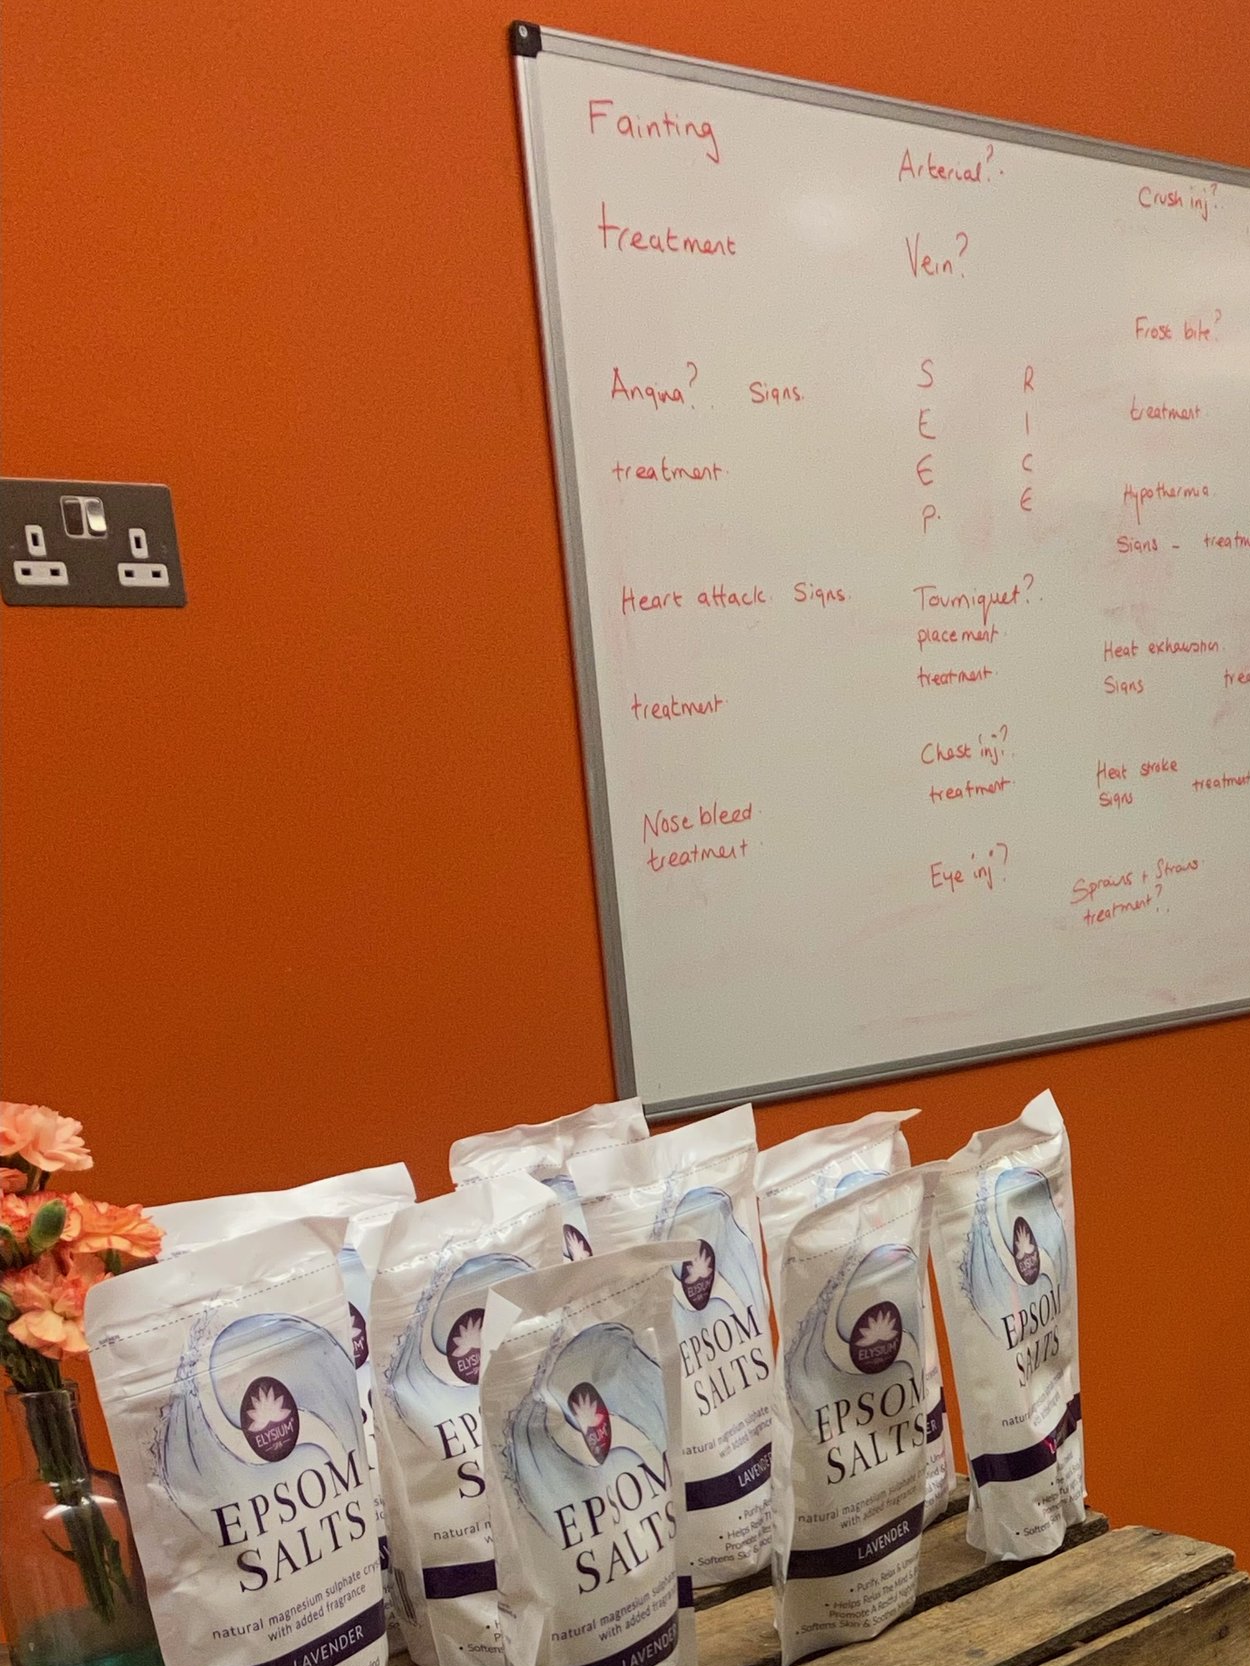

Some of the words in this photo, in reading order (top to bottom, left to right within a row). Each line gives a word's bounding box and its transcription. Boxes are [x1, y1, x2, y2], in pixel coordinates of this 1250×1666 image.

[588, 99, 721, 164] Fainting
[1138, 186, 1183, 208] Crush
[597, 200, 737, 256] treatment
[905, 231, 969, 278] Vein?
[1134, 316, 1173, 341] Frost
[1183, 308, 1223, 342] bite?
[1129, 395, 1200, 421] treatment
[611, 455, 723, 483] treatment
[1123, 481, 1210, 525] Hypothermia
[1116, 536, 1159, 554] Signs
[621, 586, 683, 615] Heart
[697, 584, 767, 609] attack
[1104, 639, 1139, 662] Heat
[917, 666, 993, 688] treatment
[1104, 675, 1144, 693] Signs
[631, 693, 724, 720] treatment
[921, 742, 972, 765] Chest
[1096, 758, 1128, 789] Heat
[1140, 756, 1179, 777] stroke
[929, 778, 1011, 804] treatment
[1099, 791, 1134, 810] Signs
[646, 838, 749, 872] treatment
[929, 861, 965, 893] Eye
[1000, 1282, 1063, 1352] EPSOM
[678, 1304, 764, 1380] EPSOM
[1015, 1323, 1061, 1389] SALTS
[693, 1346, 771, 1418] SALTS
[814, 1375, 927, 1446] EPSOM
[825, 1411, 927, 1487] SALTS
[210, 1448, 364, 1549] EPSOM
[552, 1448, 674, 1551] EPSOM
[235, 1499, 367, 1594] SALTS
[575, 1499, 678, 1596] SALTS
[857, 1519, 911, 1561] LAVENDER
[212, 1617, 265, 1641] natural
[268, 1592, 325, 1627] magnesium
[325, 1568, 363, 1598] sulphate
